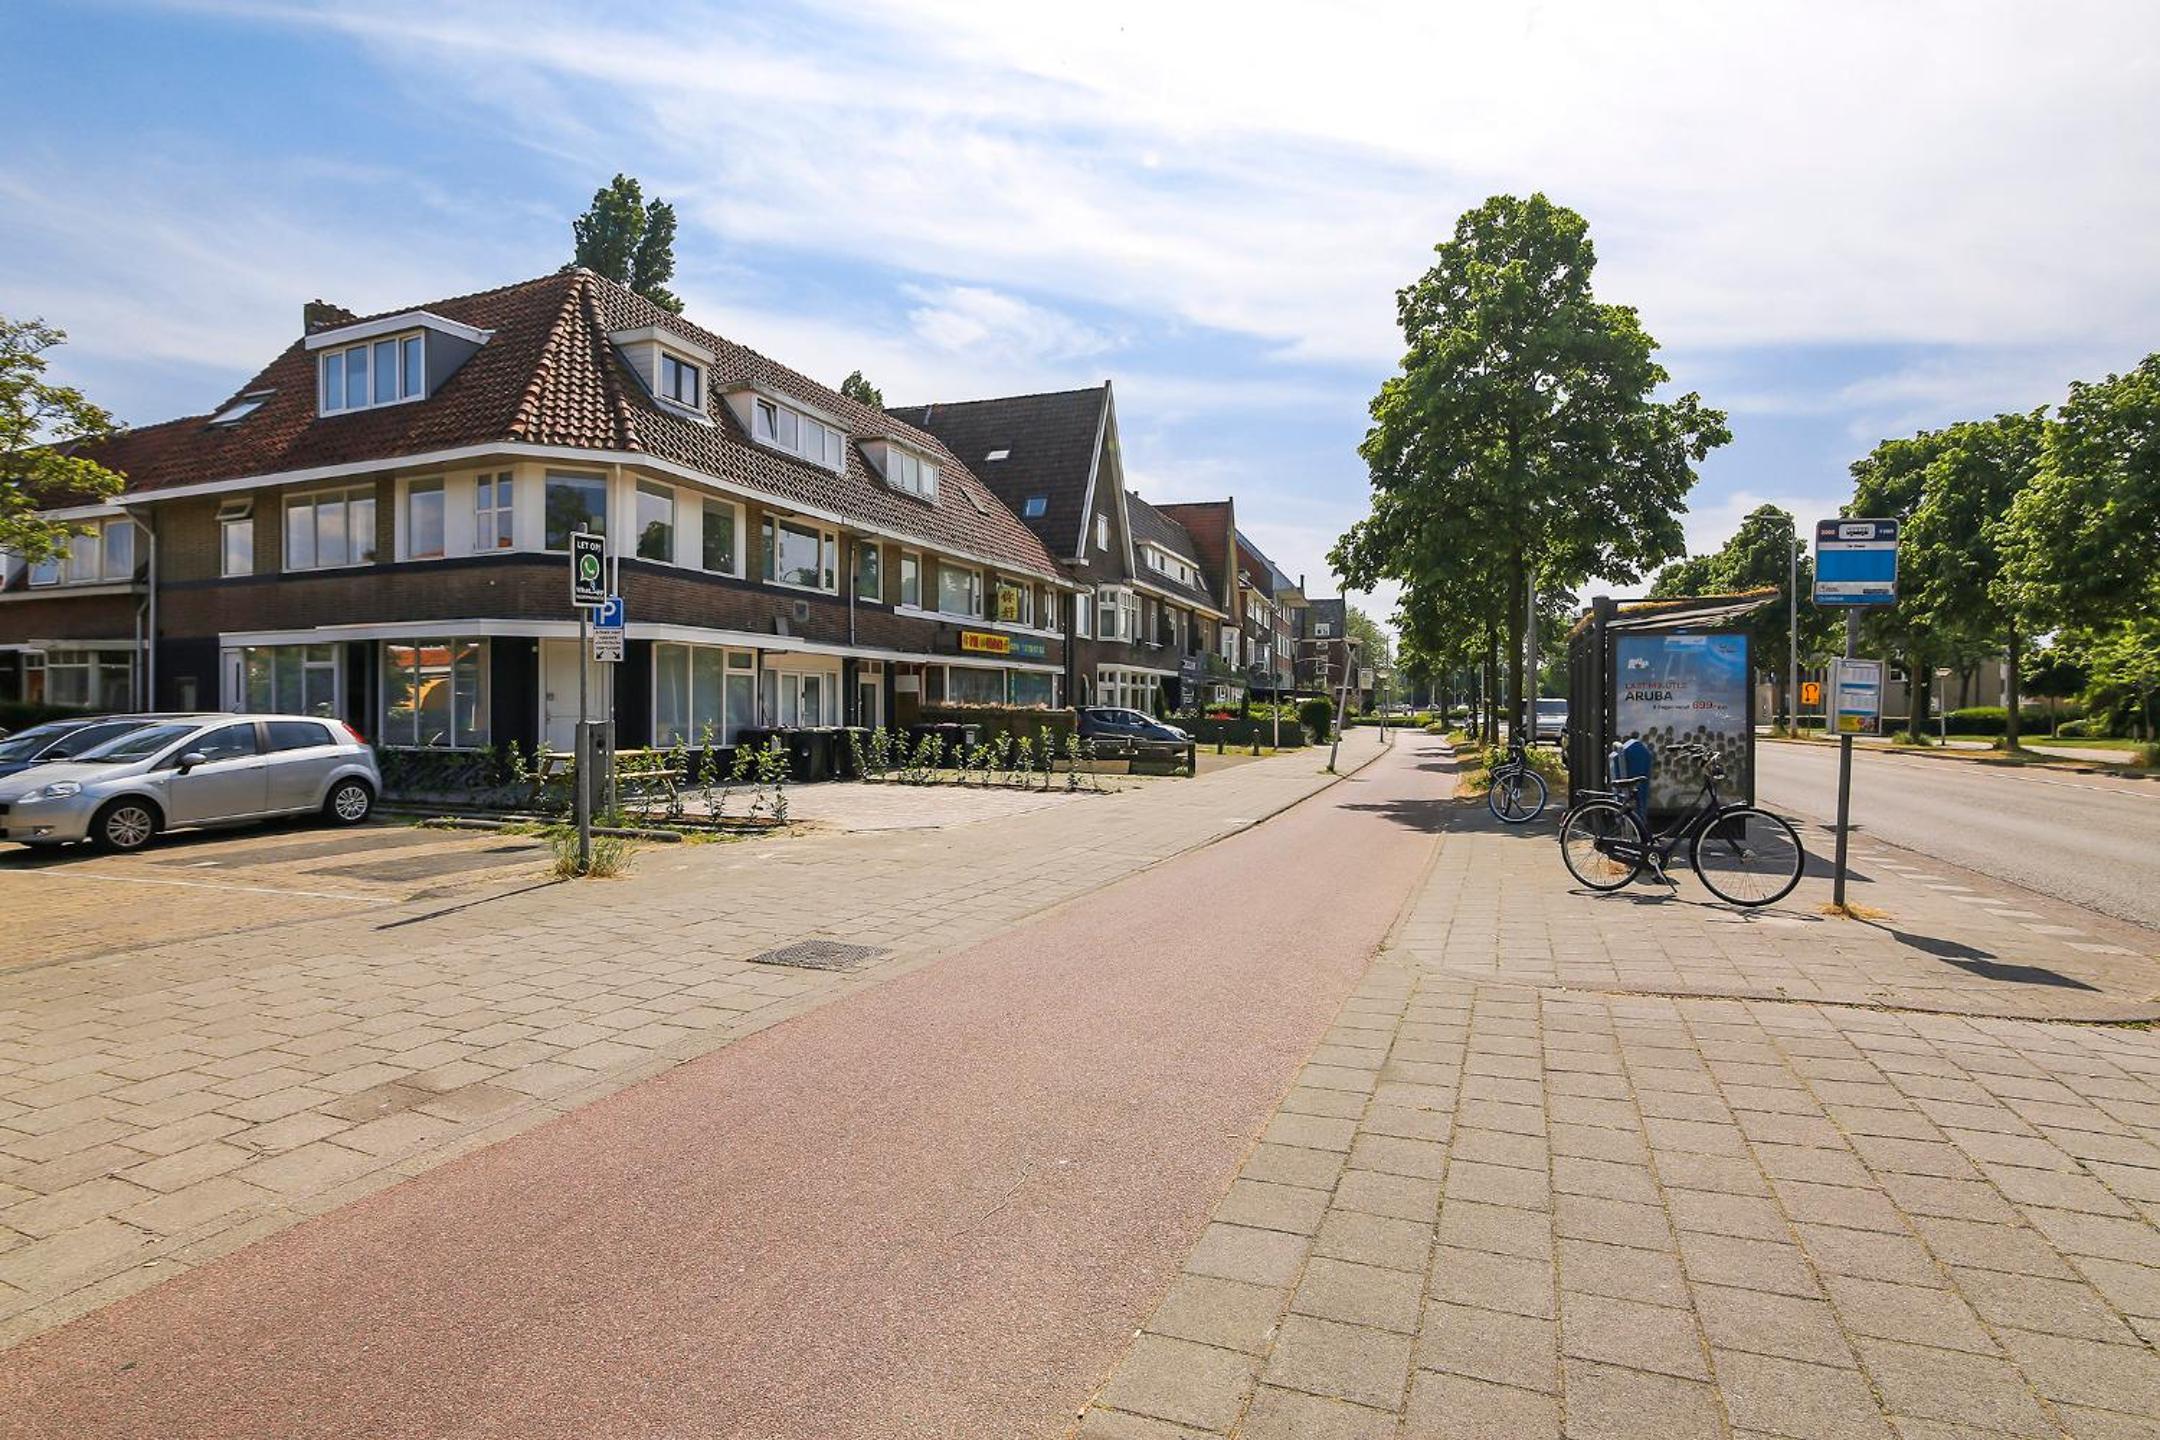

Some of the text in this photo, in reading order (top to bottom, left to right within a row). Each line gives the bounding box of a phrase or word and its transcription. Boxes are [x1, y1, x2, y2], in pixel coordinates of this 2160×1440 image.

[577, 540, 589, 550] LET
[600, 601, 616, 625] P
[1624, 690, 1673, 701] ARUBA
